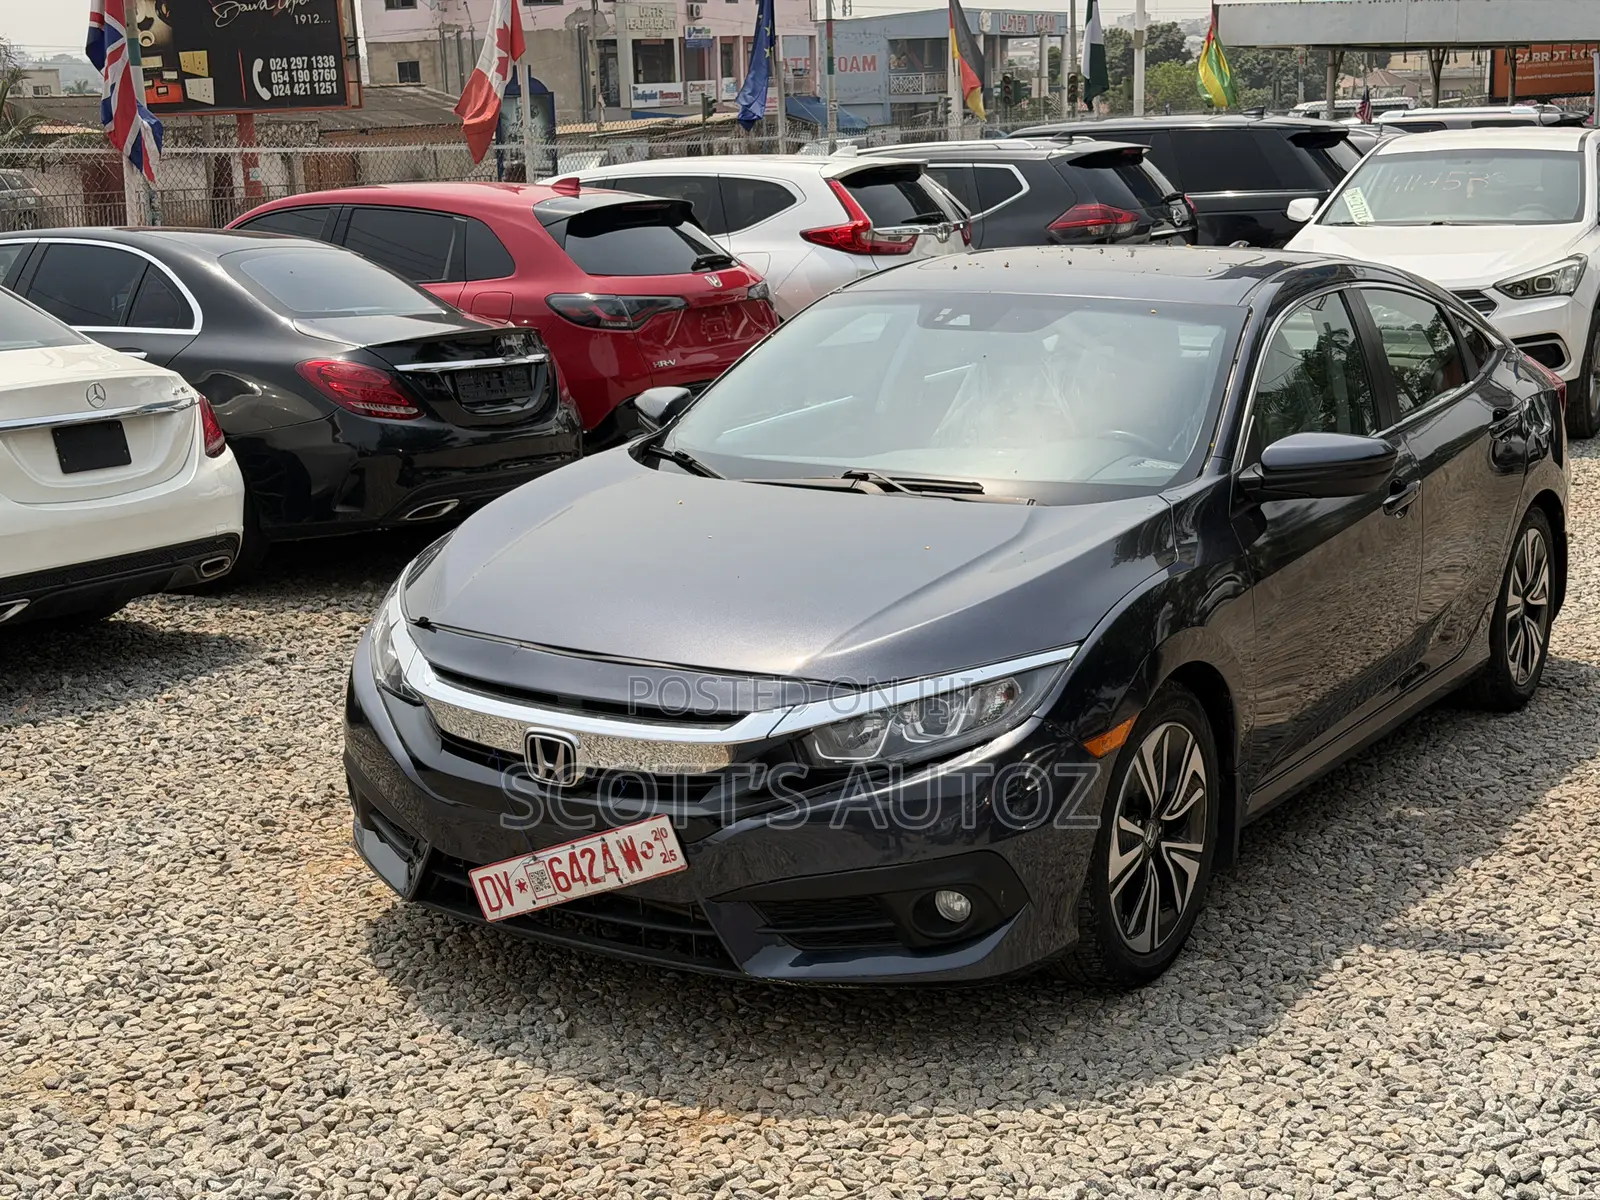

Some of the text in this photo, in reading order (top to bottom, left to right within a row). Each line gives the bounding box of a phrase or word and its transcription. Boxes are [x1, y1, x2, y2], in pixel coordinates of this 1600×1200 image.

[294, 13, 331, 25] 1912...
[1000, 12, 1028, 33] LATEX
[269, 55, 336, 71] 024 297 1338
[833, 54, 877, 73] OAM
[271, 68, 337, 83] 054 190 8760
[272, 81, 338, 97] 024 421 1251
[651, 358, 674, 368] HR-V
[478, 834, 643, 913] DV 6424 W
